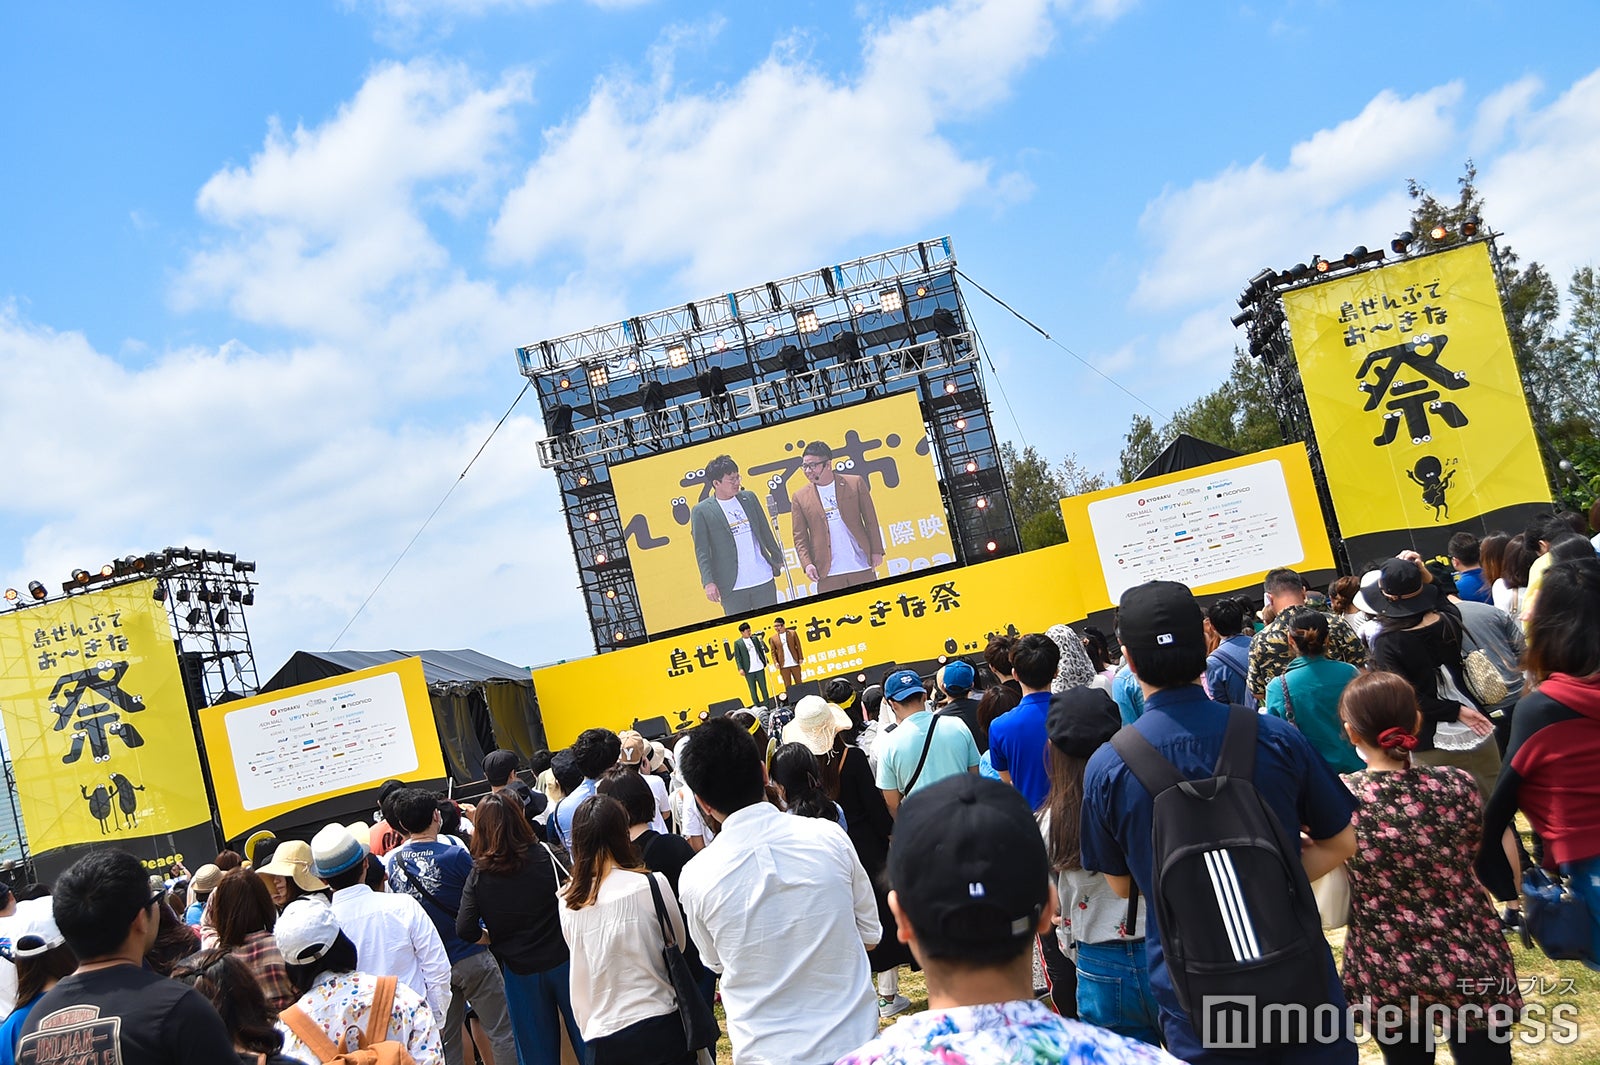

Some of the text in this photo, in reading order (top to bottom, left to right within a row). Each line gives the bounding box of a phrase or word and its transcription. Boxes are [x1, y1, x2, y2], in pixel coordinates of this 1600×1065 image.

[1339, 278, 1441, 323] 島ぜんぶで
[1355, 332, 1470, 446] 祭
[879, 513, 947, 550] 際映
[827, 656, 863, 675] Peace
[48, 660, 146, 764] 祭
[622, 747, 634, 761] Y
